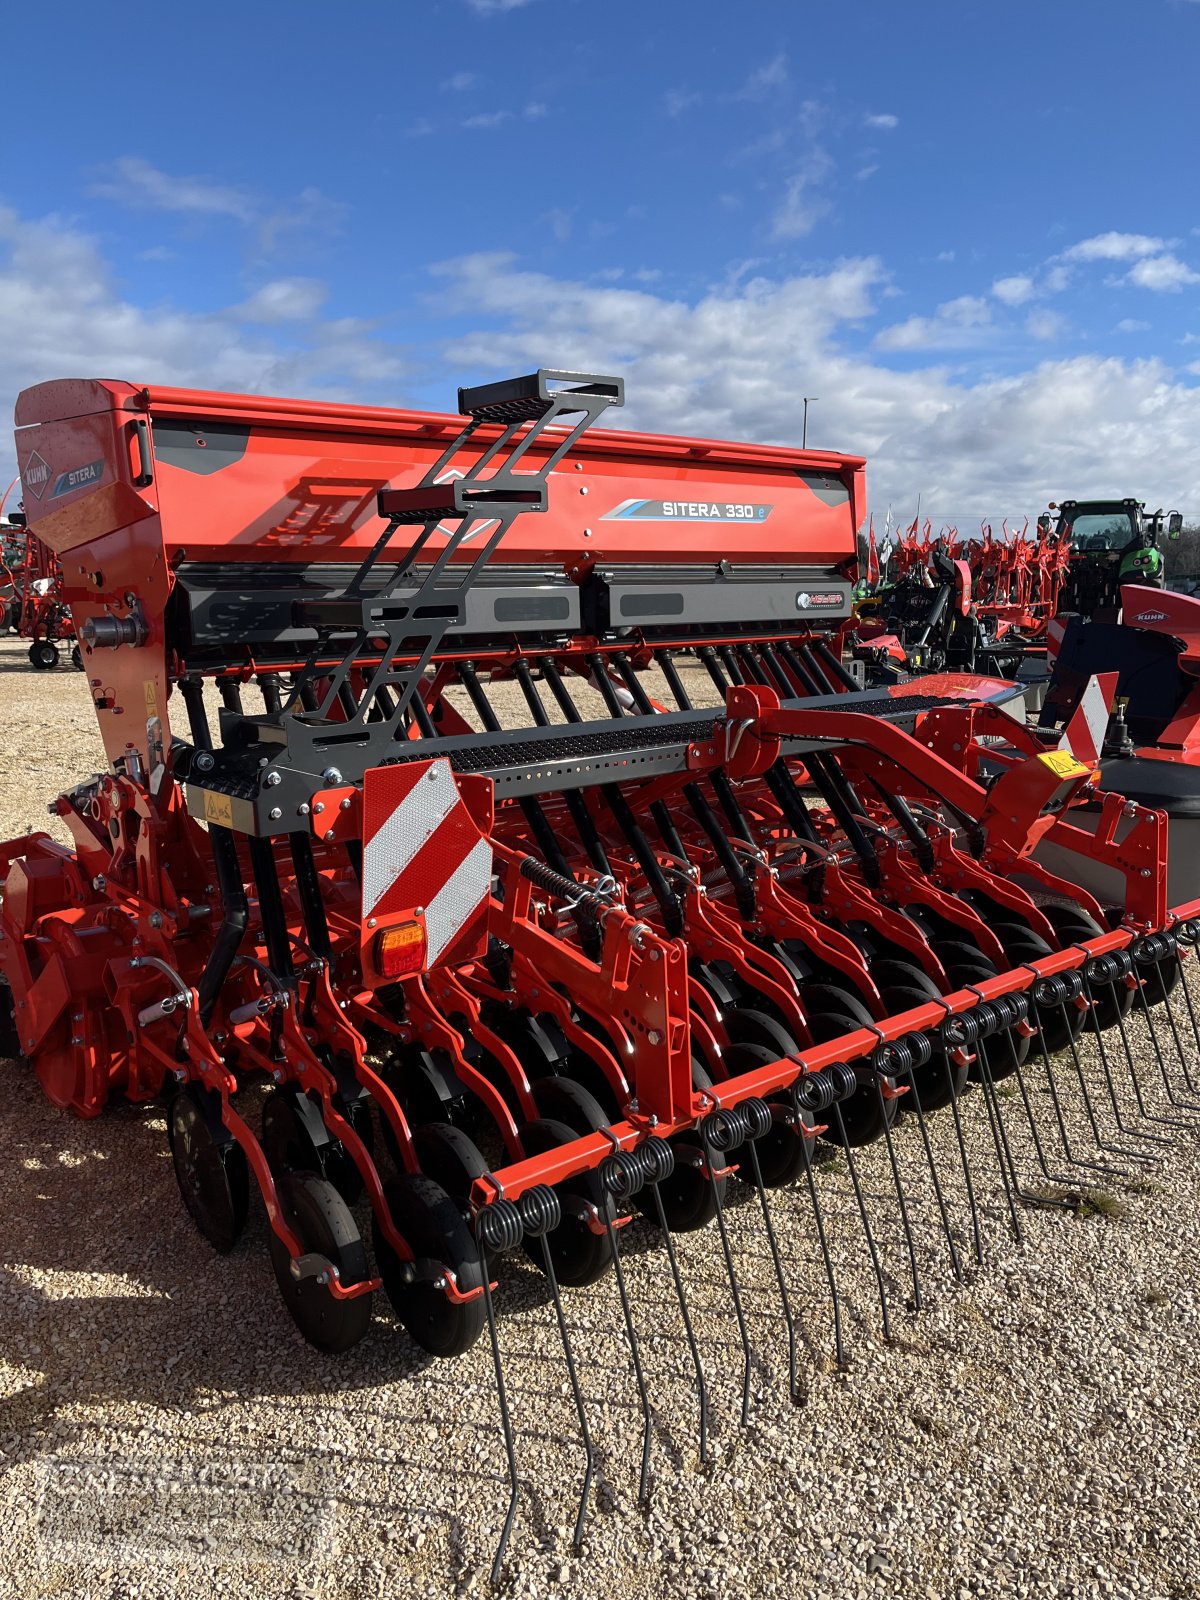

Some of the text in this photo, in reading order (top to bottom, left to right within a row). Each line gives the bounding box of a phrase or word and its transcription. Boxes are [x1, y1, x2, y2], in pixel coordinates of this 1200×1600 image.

[26, 465, 48, 485] KUHN
[68, 465, 96, 485] SITERA
[662, 502, 721, 517] SITERA
[725, 505, 754, 518] 330
